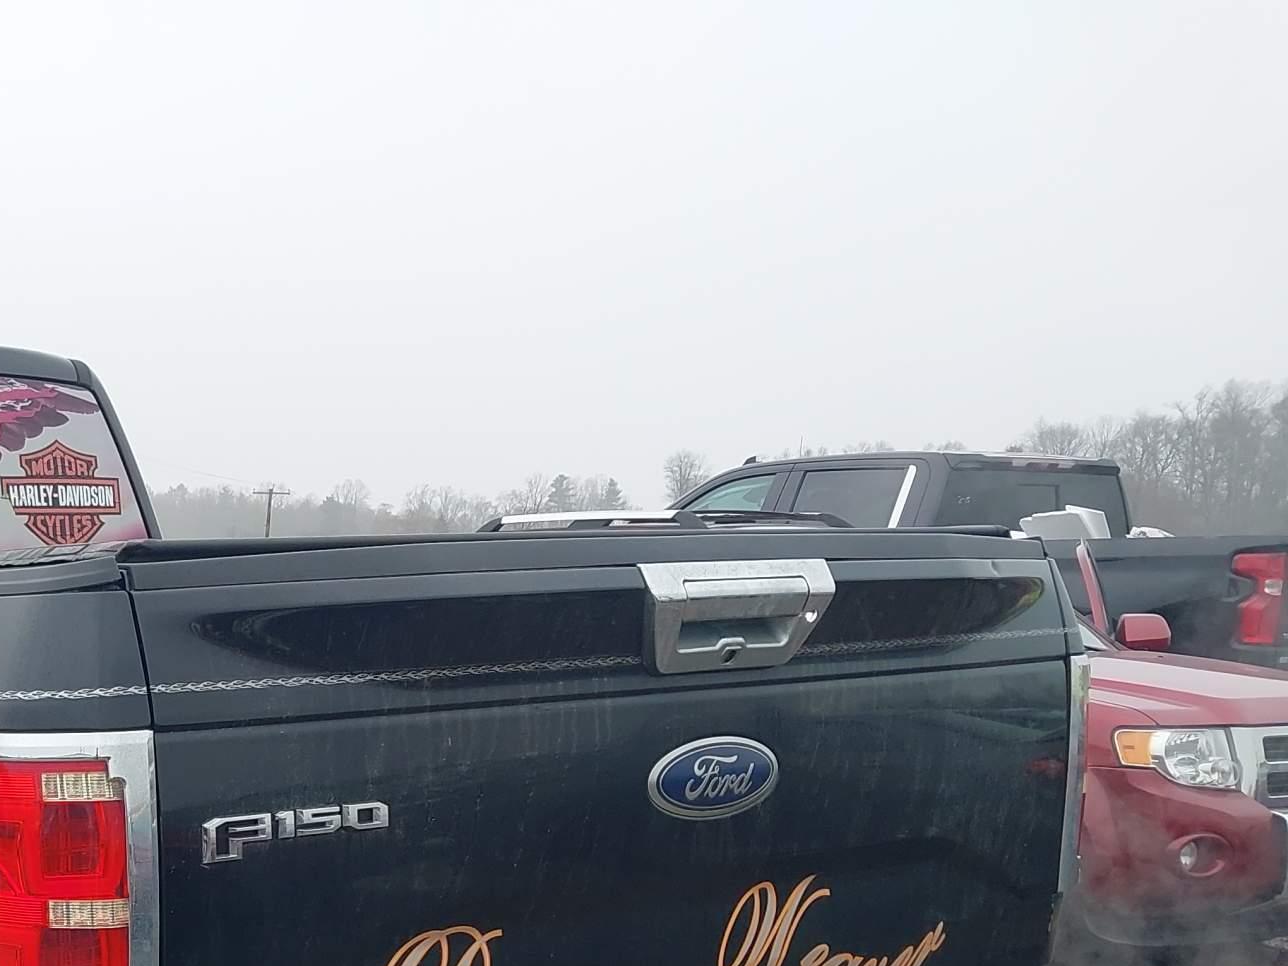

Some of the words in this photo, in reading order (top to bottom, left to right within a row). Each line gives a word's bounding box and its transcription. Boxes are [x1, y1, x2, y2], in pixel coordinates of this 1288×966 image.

[31, 451, 89, 477] MOTOR
[9, 485, 114, 507] HARLEY-DAVIDSON
[36, 515, 92, 544] CYCLES
[685, 755, 755, 800] Ford
